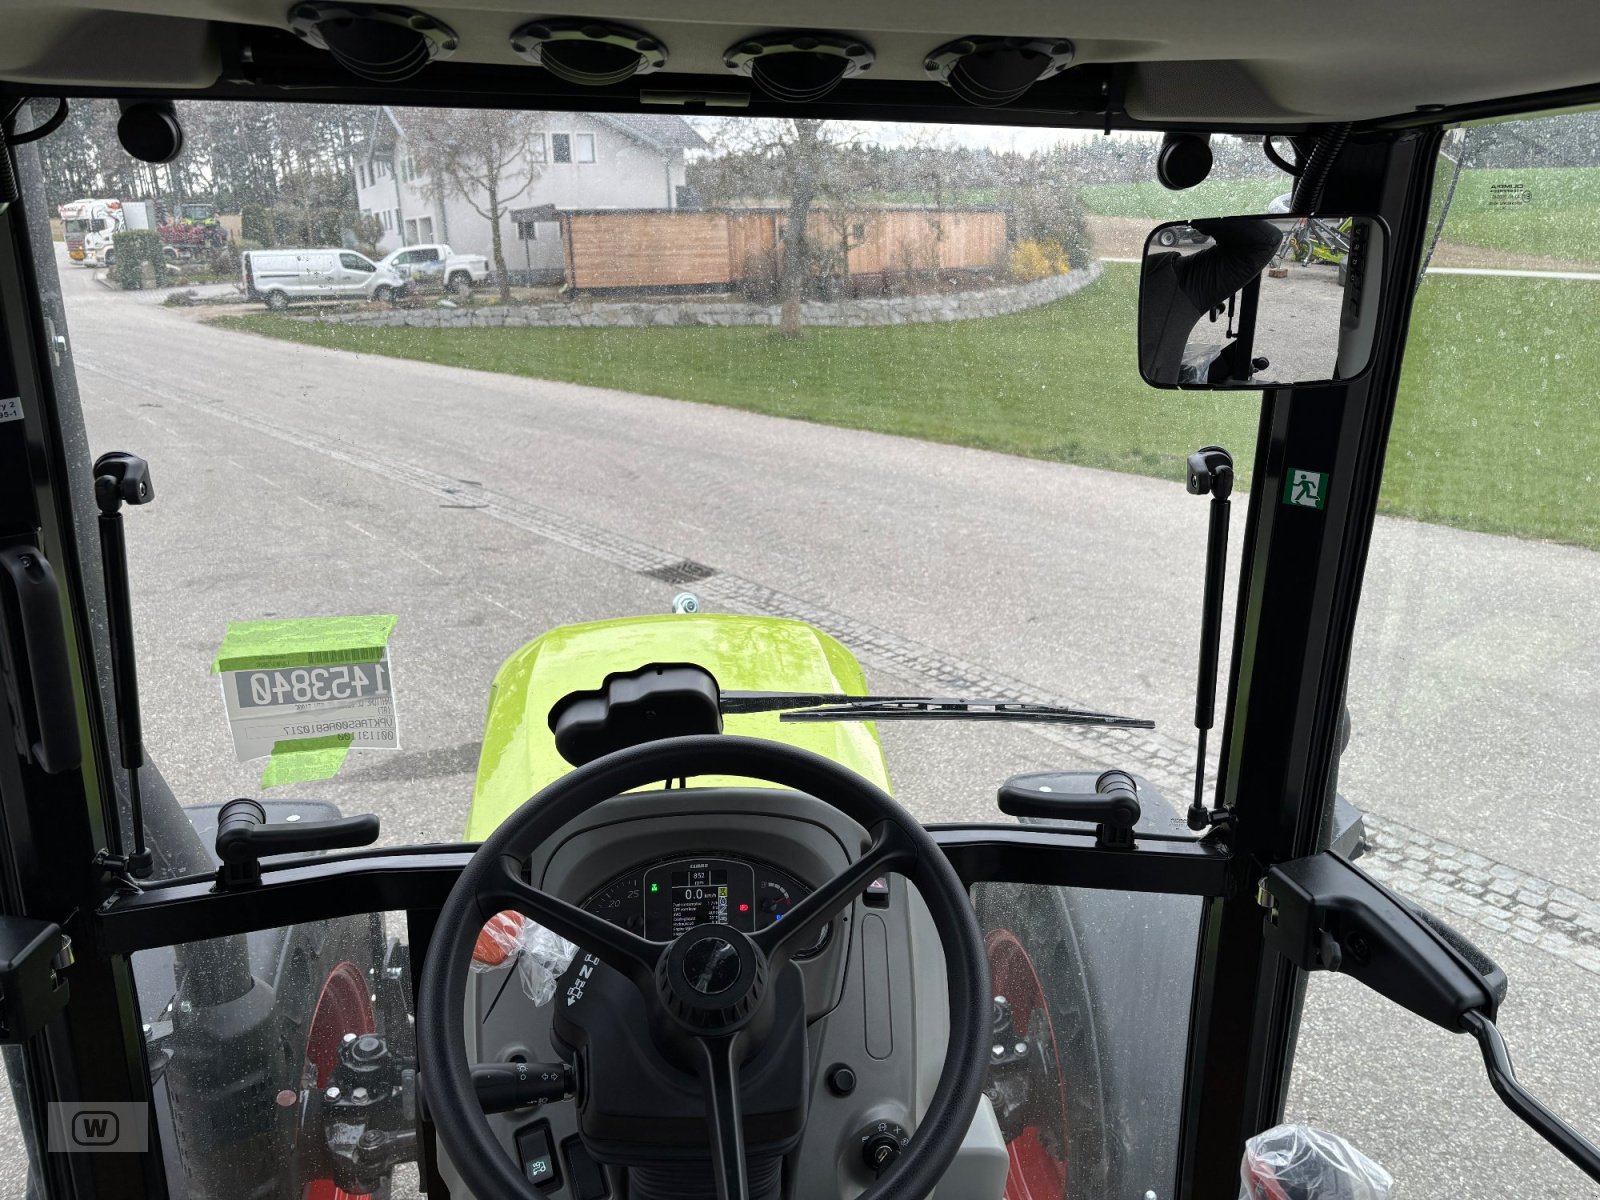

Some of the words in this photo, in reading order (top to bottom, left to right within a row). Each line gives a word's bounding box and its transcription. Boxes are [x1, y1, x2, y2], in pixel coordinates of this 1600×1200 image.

[627, 890, 640, 899] 25
[685, 889, 703, 900] 0.0
[608, 899, 621, 908] 20
[578, 964, 594, 979] N
